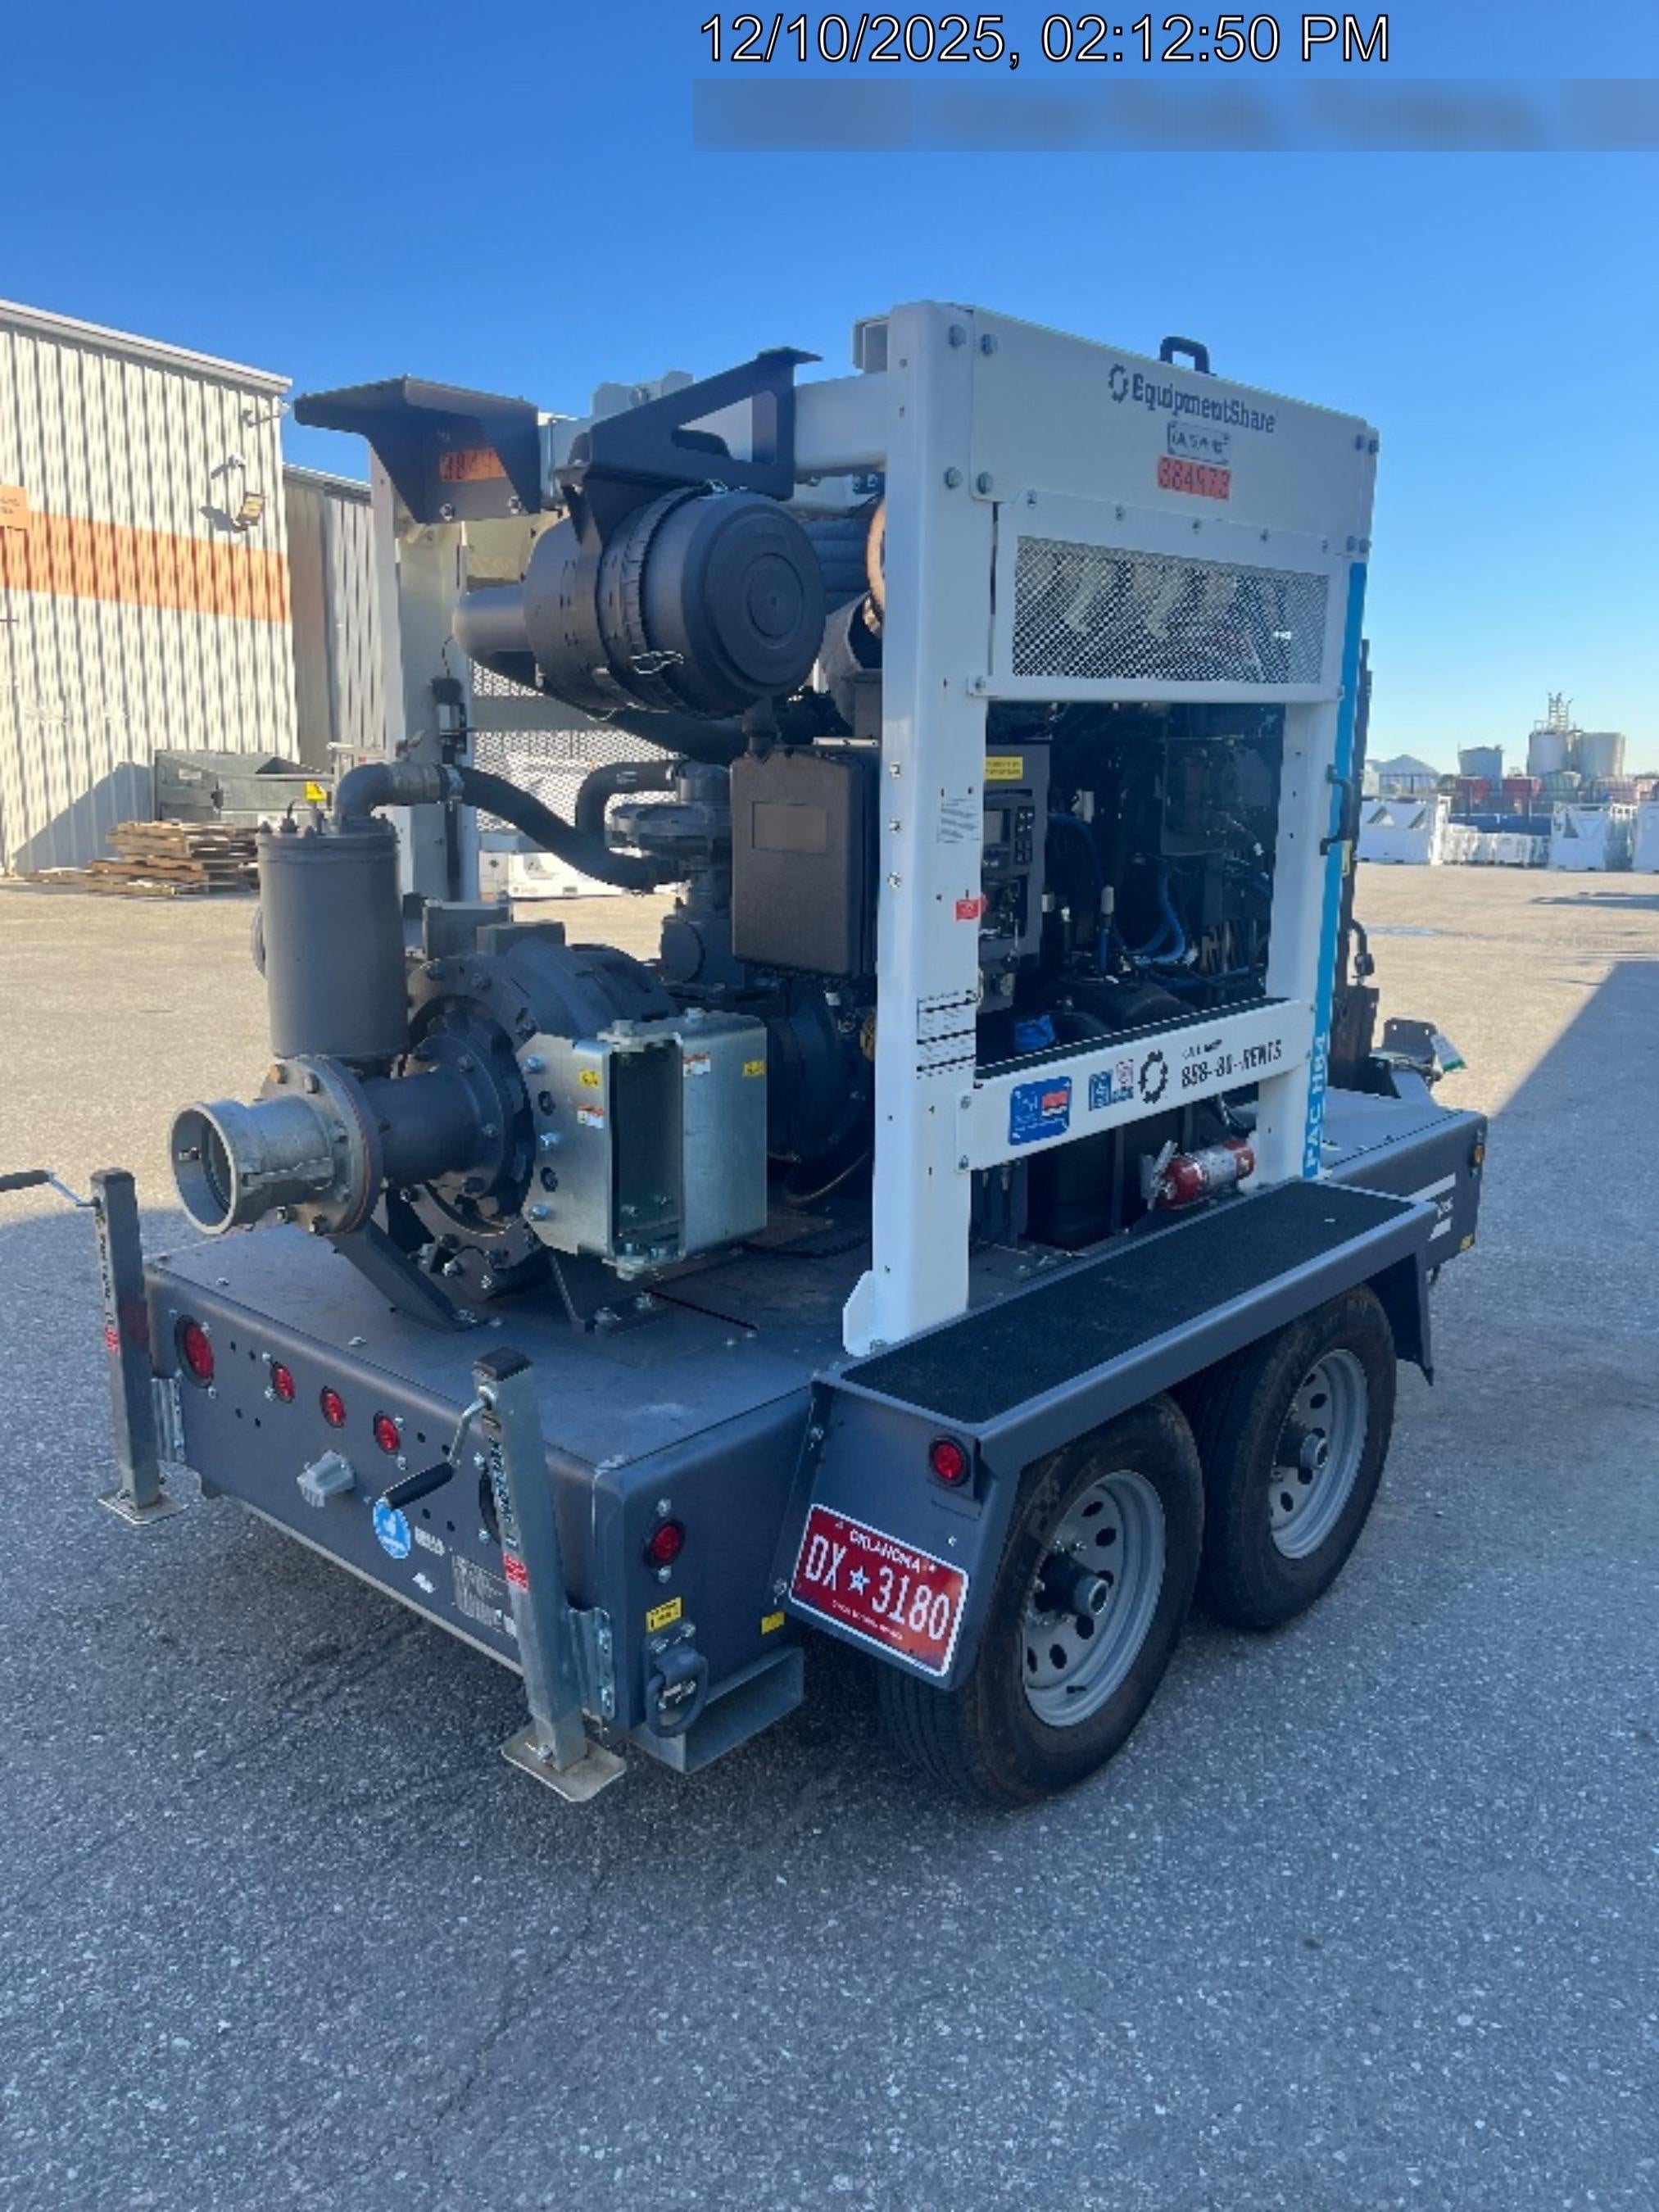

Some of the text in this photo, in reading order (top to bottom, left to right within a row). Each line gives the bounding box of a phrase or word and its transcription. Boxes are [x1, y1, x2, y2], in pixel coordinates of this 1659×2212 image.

[1131, 374, 1275, 433] EquipmentShare
[1306, 1103, 1321, 1168] PAC
[850, 1528, 921, 1574] OKLAHOMA
[805, 1534, 847, 1592] DX
[872, 1566, 950, 1641] 3180
